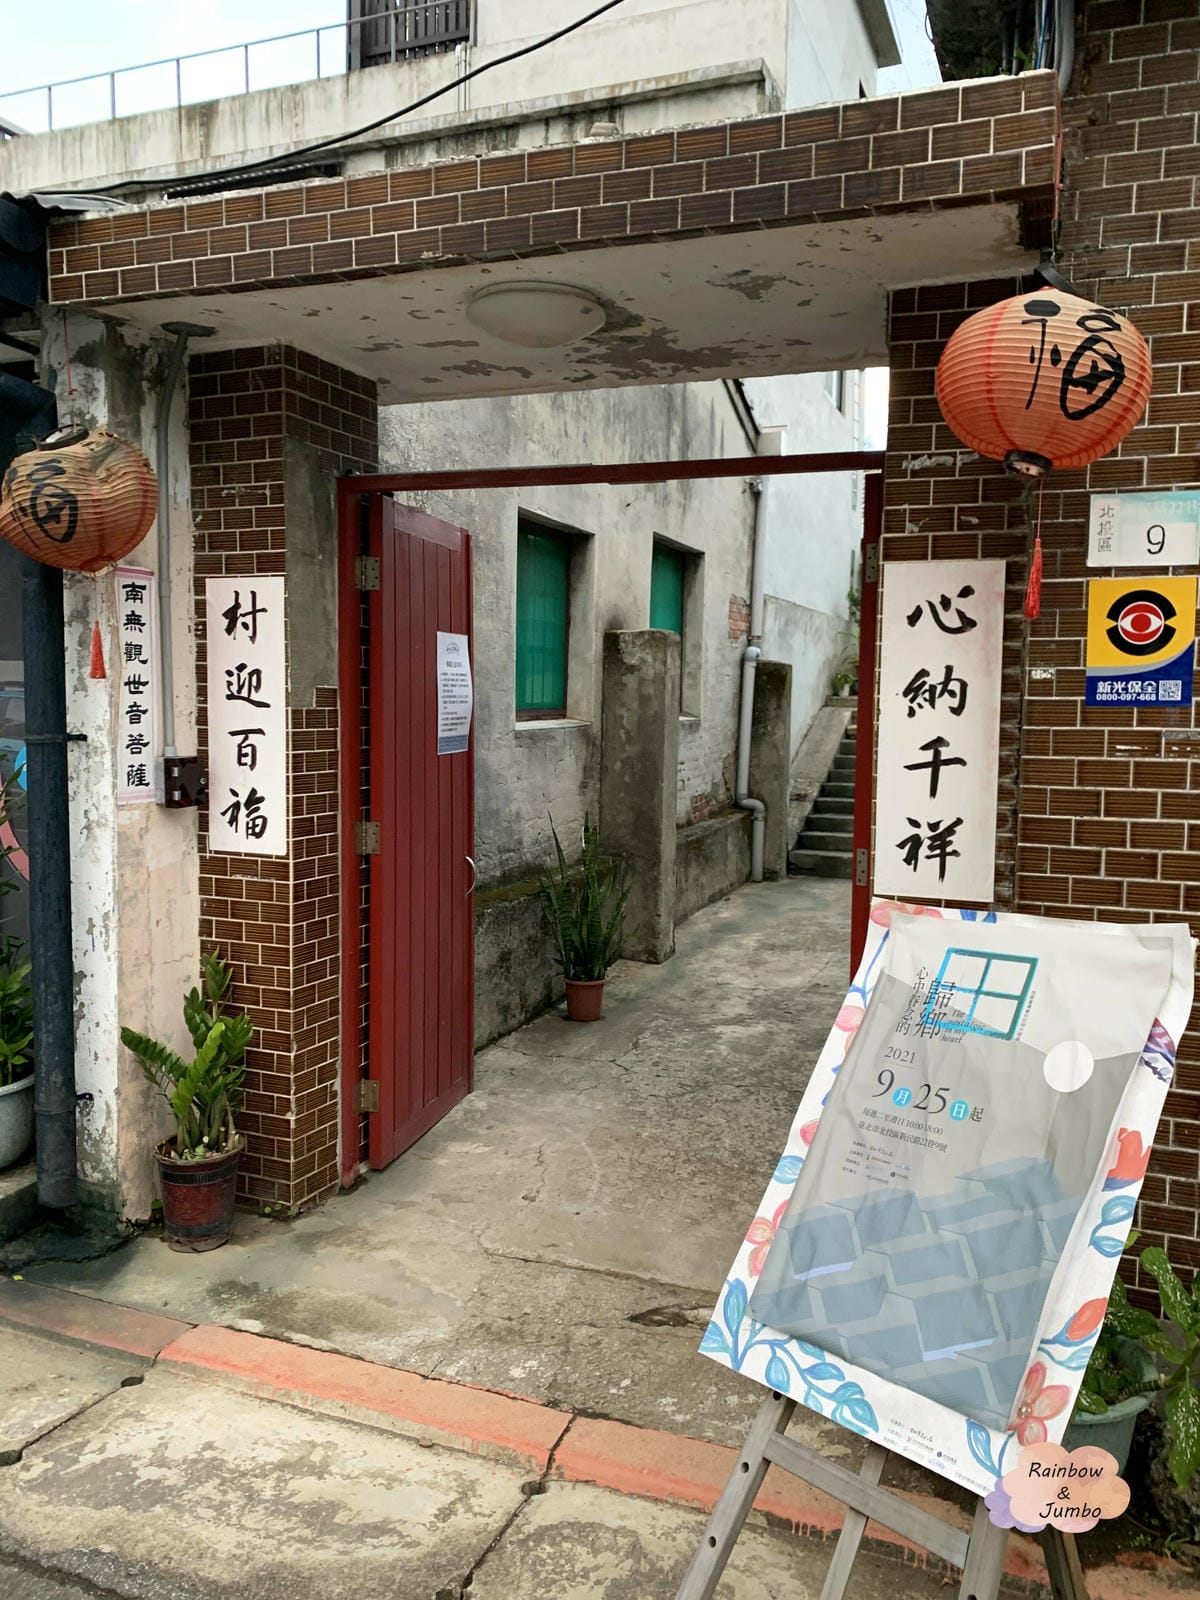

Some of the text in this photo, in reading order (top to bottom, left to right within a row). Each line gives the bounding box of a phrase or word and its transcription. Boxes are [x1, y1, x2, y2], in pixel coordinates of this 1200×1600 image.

[1020, 299, 1126, 420] 福
[1097, 504, 1115, 552] 北投區
[1146, 524, 1166, 555] 9
[122, 581, 151, 788] 南無觀世音菩薩
[1096, 680, 1158, 693] 新光保全
[1096, 693, 1157, 701] 0800-097-668
[219, 589, 272, 840] 村迎百福
[895, 583, 979, 883] 心納千祥
[951, 1009, 967, 1018] The
[884, 1046, 916, 1064] 2021
